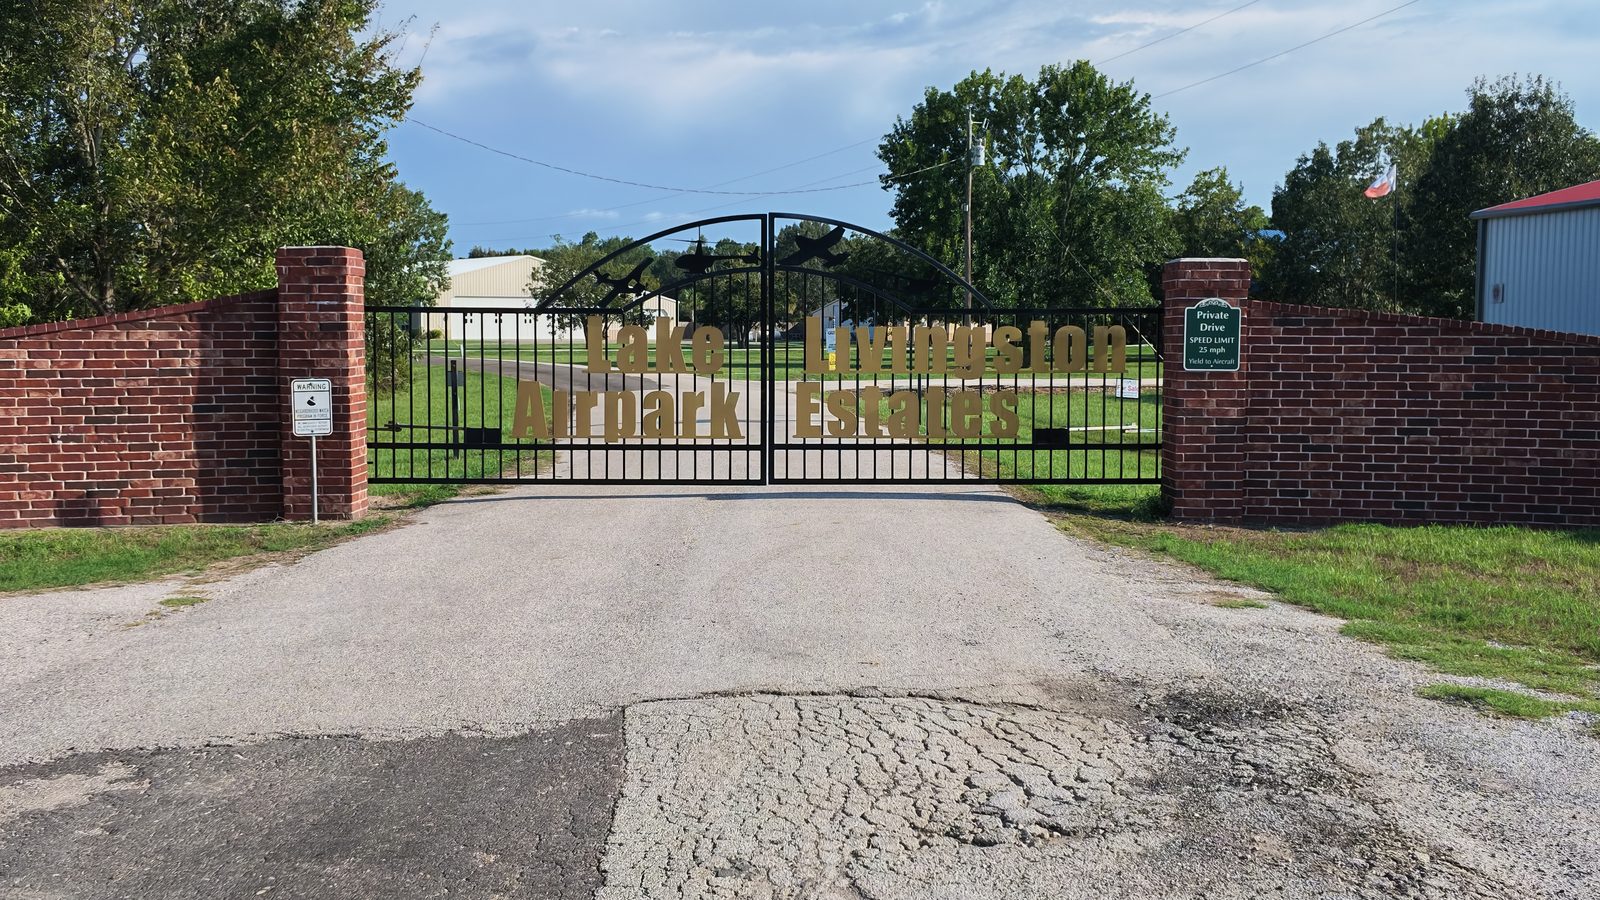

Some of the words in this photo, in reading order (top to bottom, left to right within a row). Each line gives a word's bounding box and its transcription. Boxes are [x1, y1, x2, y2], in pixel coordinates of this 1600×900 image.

[1196, 310, 1230, 320] Private
[1199, 323, 1226, 332] Drive
[1189, 336, 1213, 344] SPEED
[1214, 336, 1235, 344] LIMIT
[587, 315, 725, 374] Lake
[804, 315, 1127, 380] Livingston
[1209, 346, 1226, 355] mph
[511, 380, 745, 443] Airpark
[795, 381, 1020, 439] Estates
